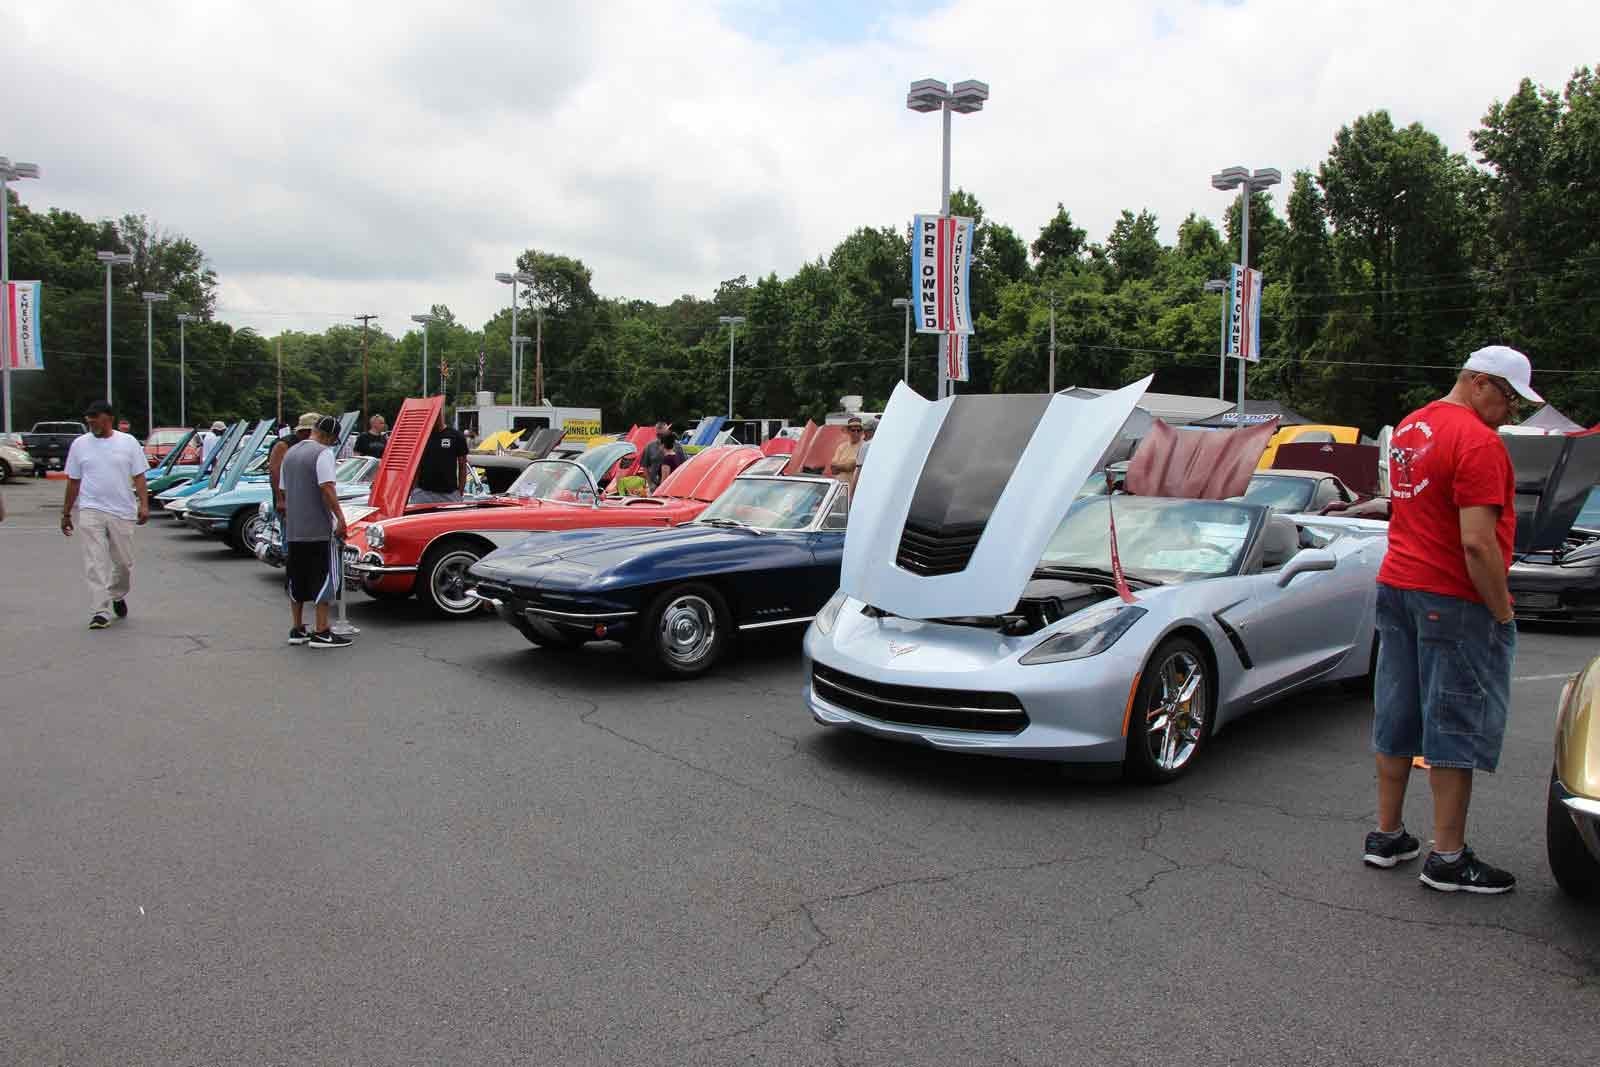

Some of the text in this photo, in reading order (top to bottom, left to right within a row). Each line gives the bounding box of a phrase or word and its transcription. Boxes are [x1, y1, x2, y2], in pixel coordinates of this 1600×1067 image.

[922, 222, 937, 328] PRE OWNED
[952, 233, 963, 327] CHEVROLET
[1235, 270, 1243, 298] PRE
[21, 294, 30, 363] CHEVROLET
